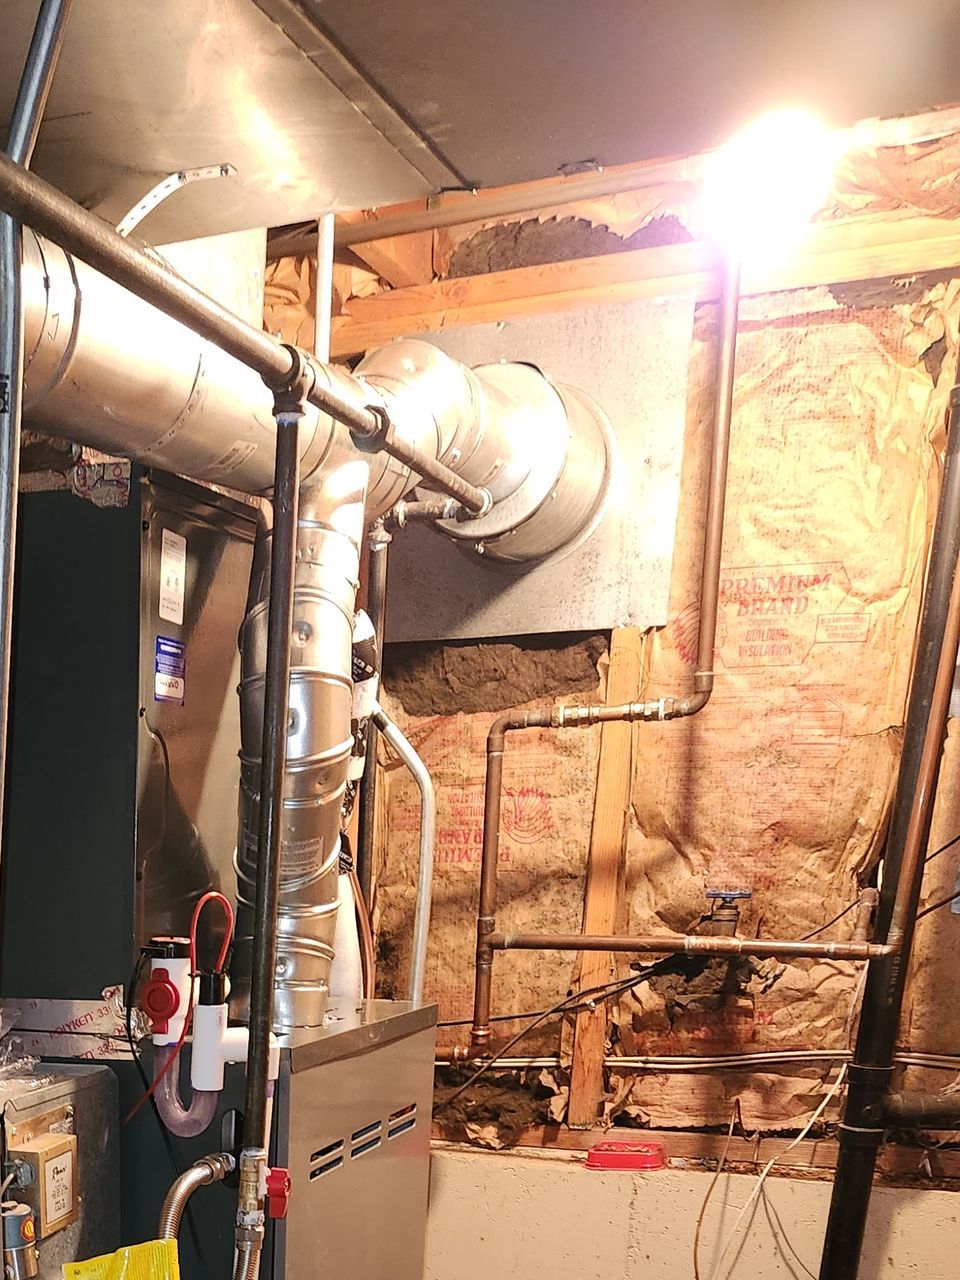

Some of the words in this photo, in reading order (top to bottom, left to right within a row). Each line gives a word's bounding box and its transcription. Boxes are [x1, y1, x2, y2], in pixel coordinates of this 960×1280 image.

[720, 573, 832, 596] PREMIUM
[737, 596, 809, 617] BRAND
[438, 828, 483, 844] RAND
[433, 847, 511, 863] PEMIU
